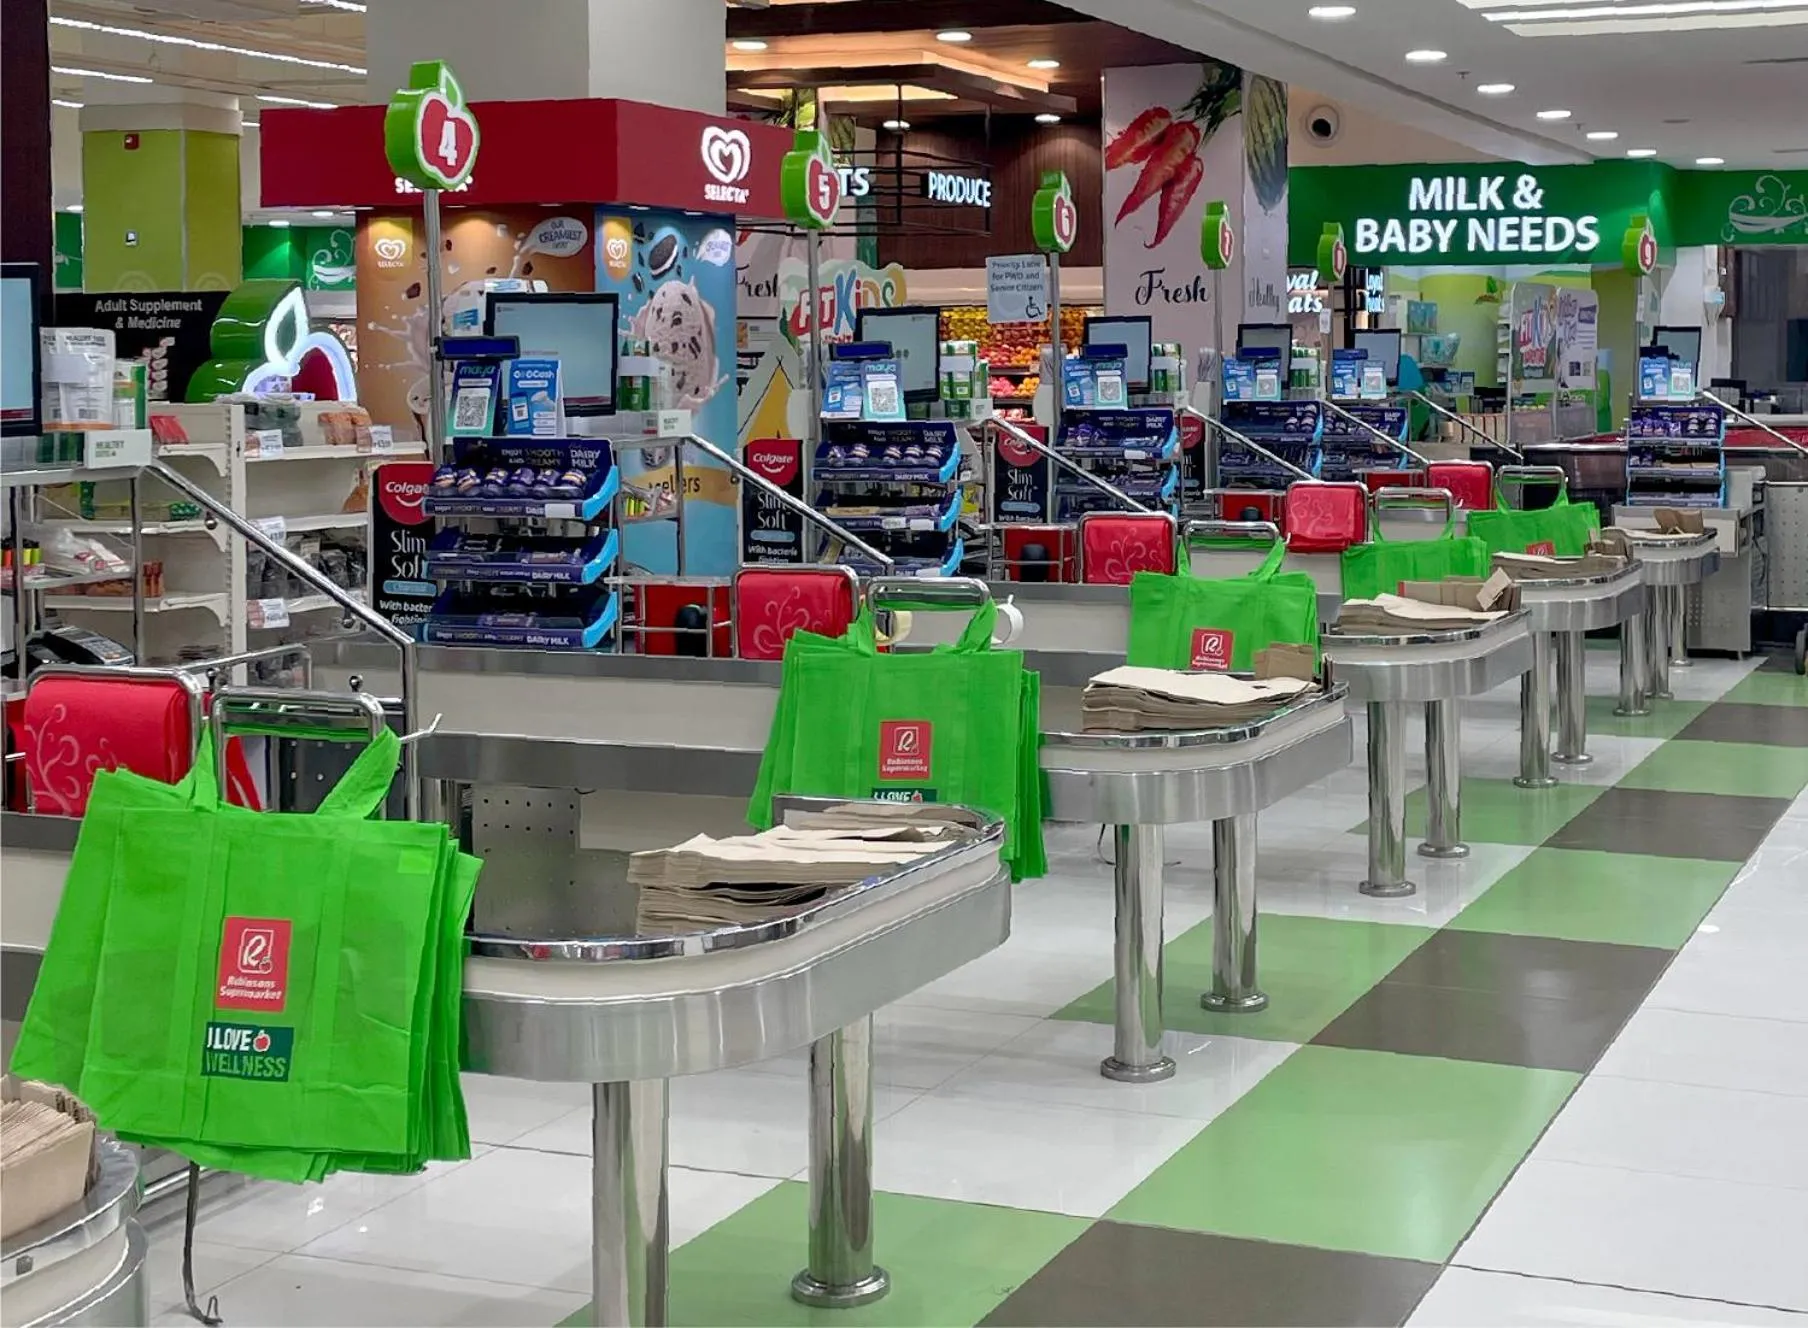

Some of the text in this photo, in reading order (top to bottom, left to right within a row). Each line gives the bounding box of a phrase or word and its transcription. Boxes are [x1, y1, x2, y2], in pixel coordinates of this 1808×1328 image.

[438, 120, 458, 166] 4
[703, 184, 749, 204] SELECTA
[818, 174, 830, 210] 5
[838, 168, 870, 196] TS
[927, 171, 991, 208] PRODUCE
[1408, 174, 1543, 212] MILK &
[1061, 207, 1071, 237] 6
[1354, 215, 1600, 254] BABY NEEDS
[1135, 267, 1208, 305] Fresh
[95, 298, 203, 315] Adult Supplement
[115, 316, 182, 329] & Medicine
[570, 449, 600, 459] DAIRY
[571, 459, 597, 469] MILK
[752, 452, 794, 465] Colgate
[1007, 468, 1033, 485] Slim
[390, 529, 426, 554] Slim
[391, 555, 427, 579] Sof
[379, 600, 433, 613] With bacter
[213, 1027, 253, 1051] LOVE
